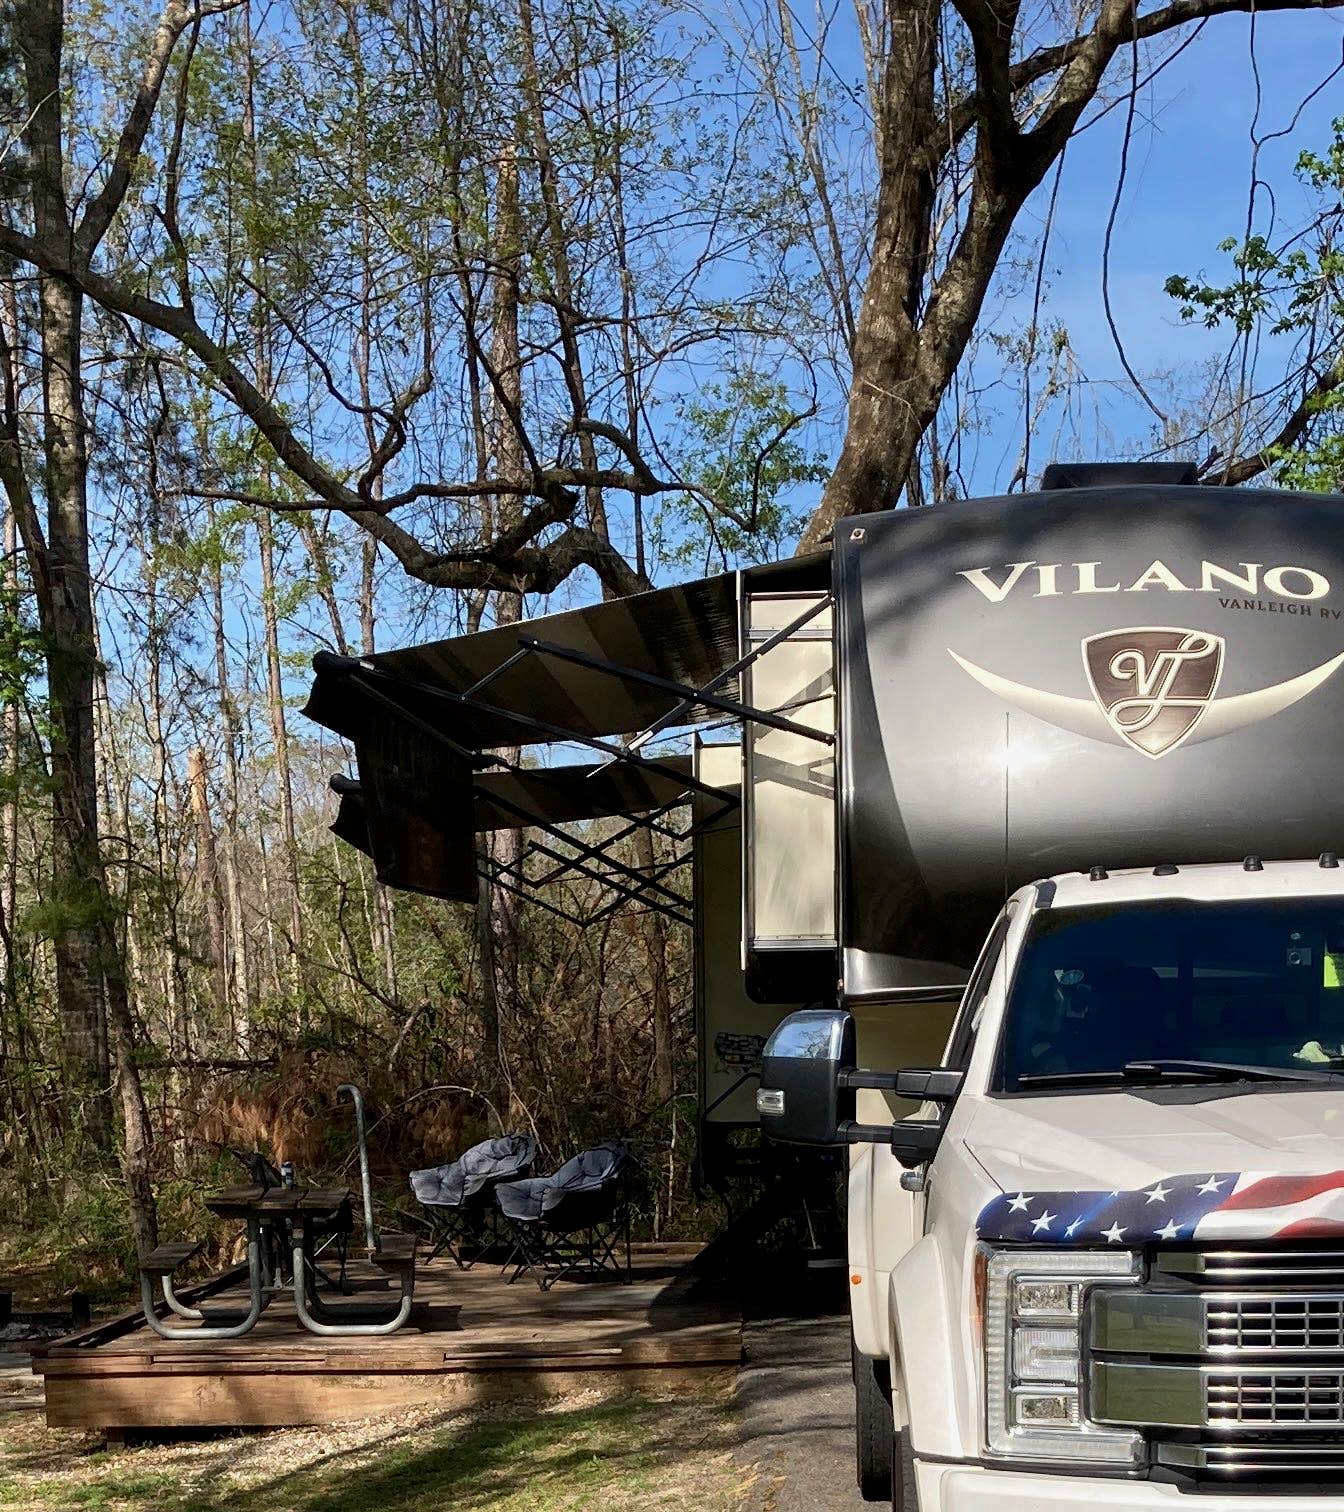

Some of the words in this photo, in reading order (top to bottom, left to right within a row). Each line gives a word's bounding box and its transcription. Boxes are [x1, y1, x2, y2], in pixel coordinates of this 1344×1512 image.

[955, 560, 1331, 602] VILANO
[1218, 598, 1313, 617] VANLEIGH
[1320, 608, 1343, 620] RV
